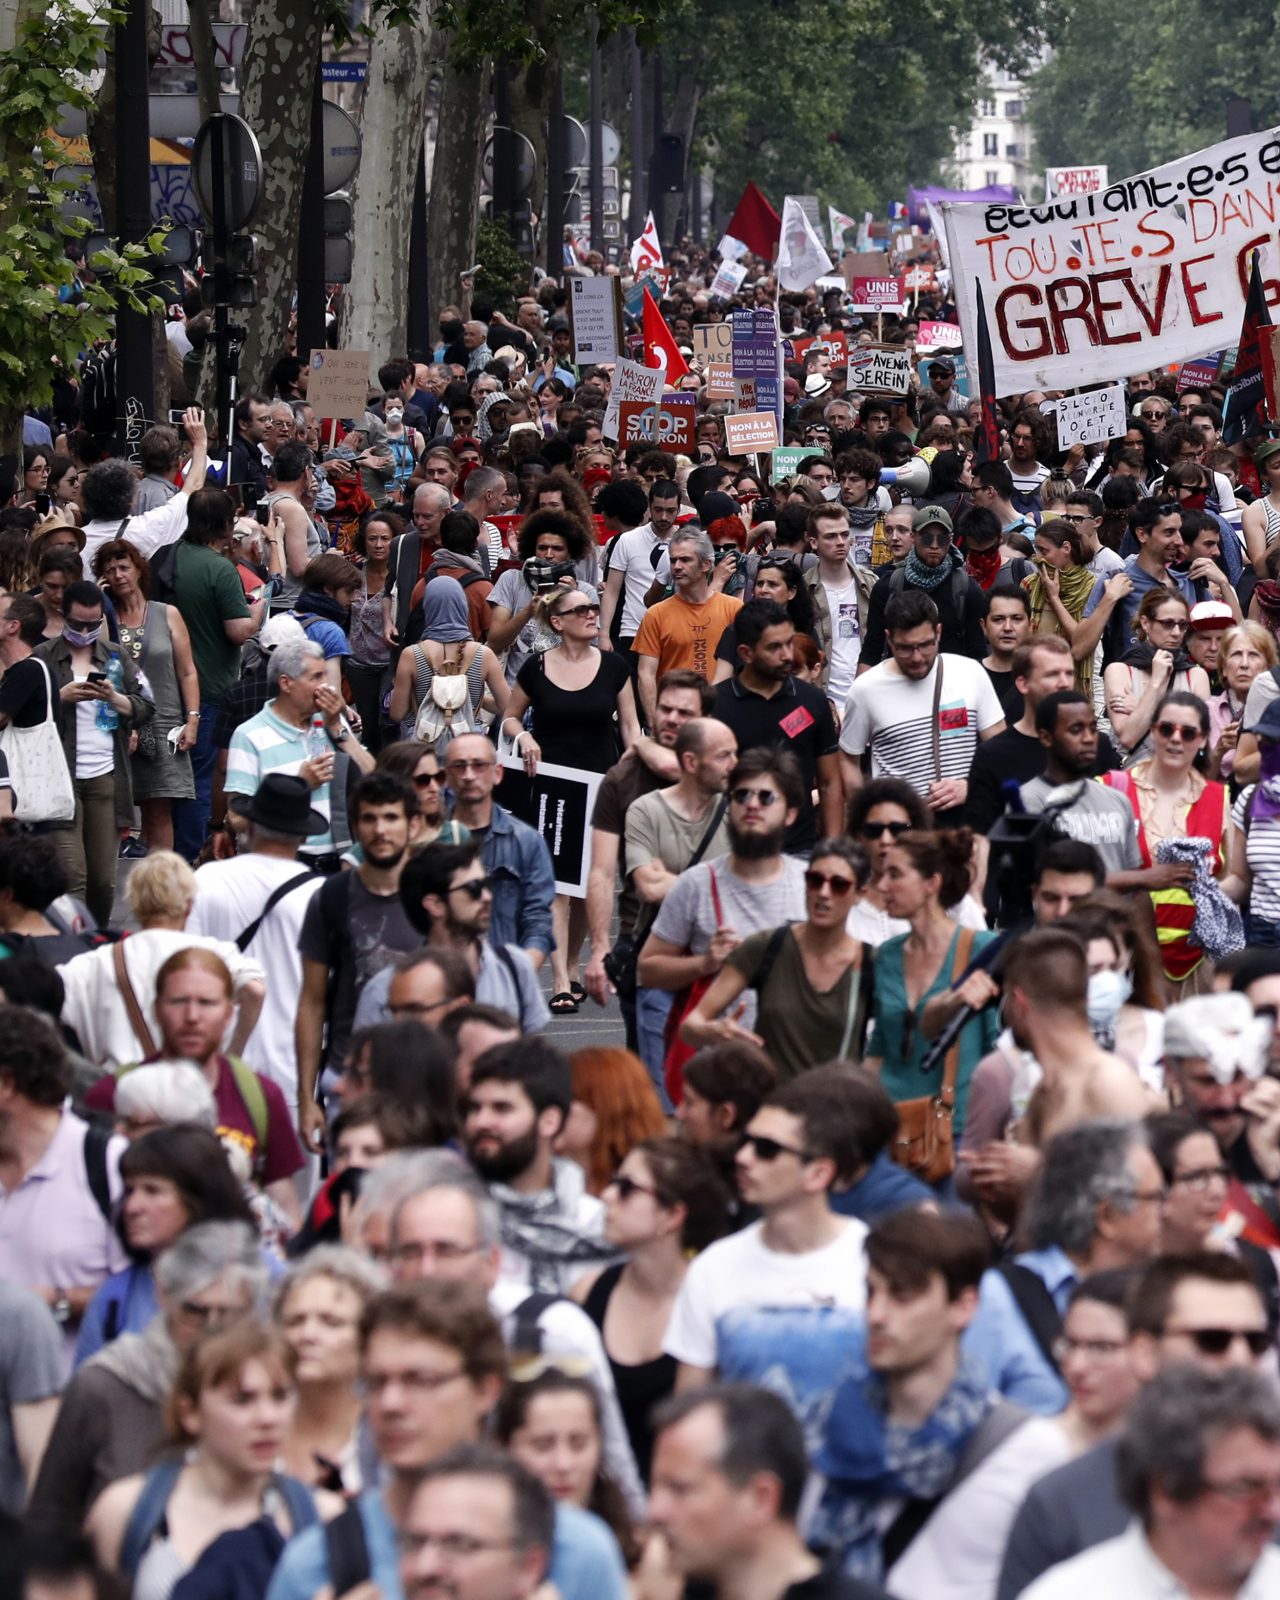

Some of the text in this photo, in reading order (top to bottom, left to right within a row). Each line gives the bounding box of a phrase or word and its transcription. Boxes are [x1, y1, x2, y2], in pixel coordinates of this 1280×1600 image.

[322, 68, 349, 77] asteur
[866, 282, 898, 293] UNIS
[995, 253, 1223, 361] GREVE
[932, 325, 962, 338] UNIS
[734, 357, 754, 366] SÉLECTION
[756, 357, 775, 366] SÉLECTION
[712, 370, 733, 379] NON
[1183, 370, 1212, 381] NON À LA
[619, 378, 628, 387] LA
[1180, 377, 1211, 388] SÉLECTION
[627, 414, 689, 433] STOP
[731, 420, 773, 433] NON À LA
[731, 431, 775, 442] SÉLECTION
[777, 455, 797, 464] NON
